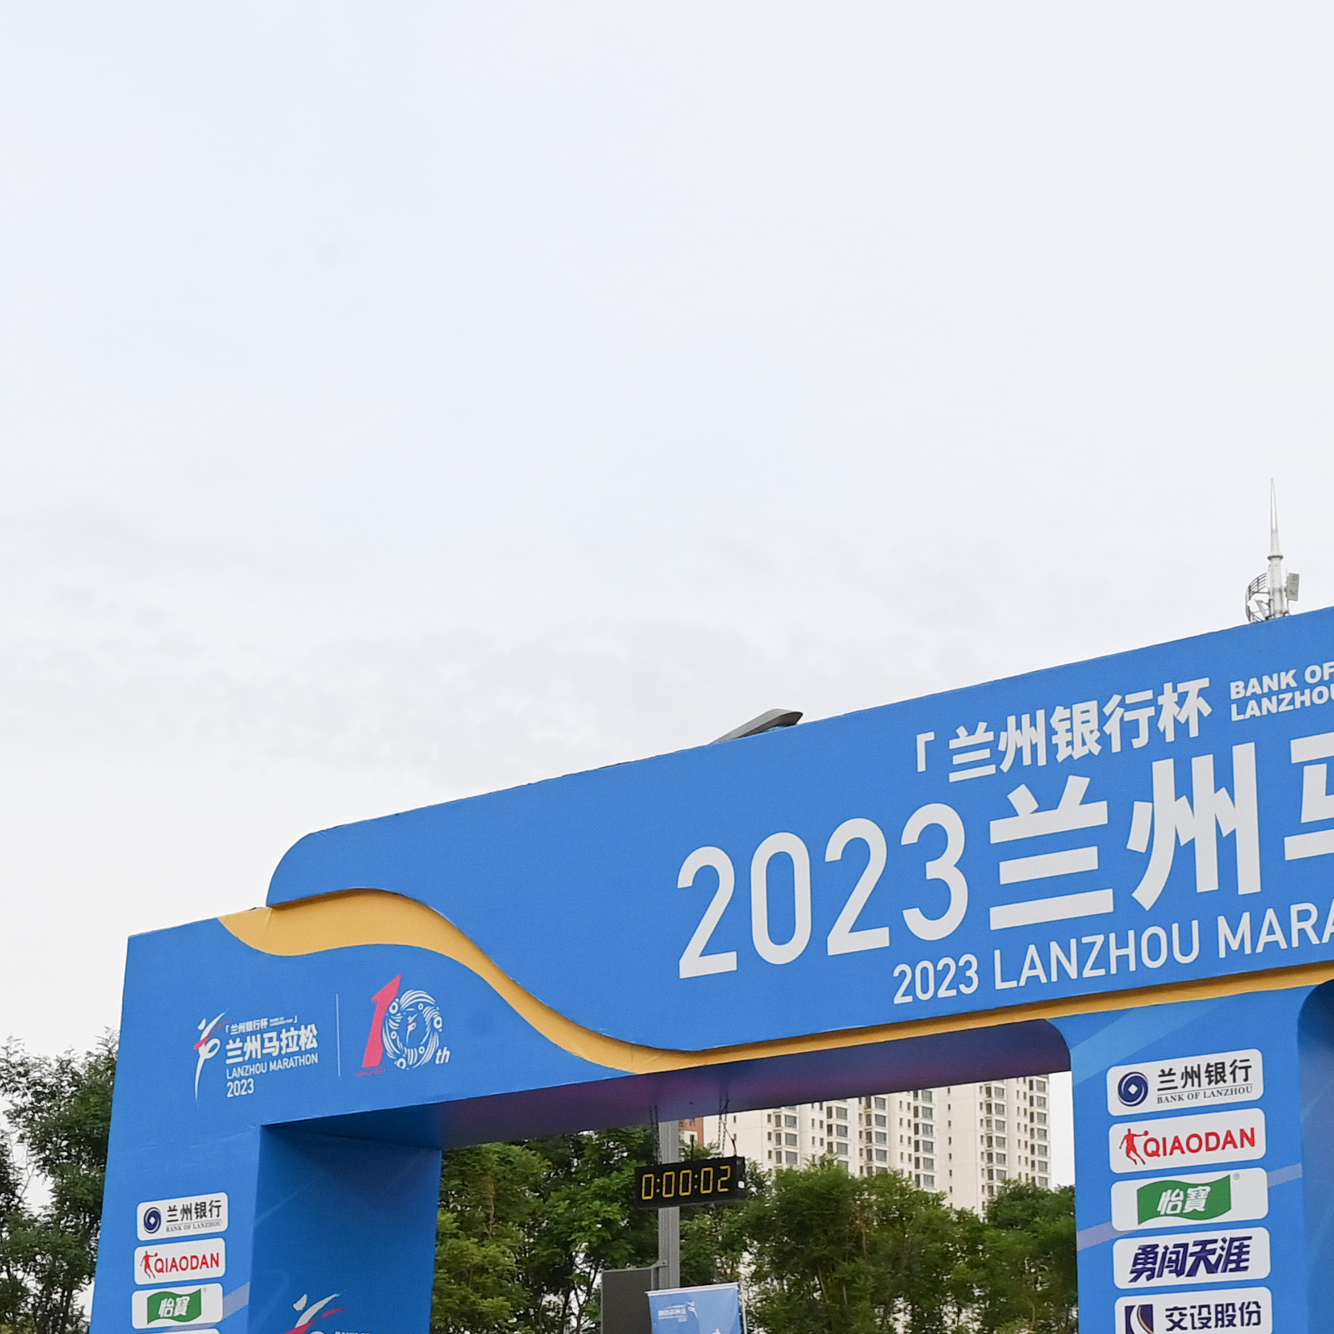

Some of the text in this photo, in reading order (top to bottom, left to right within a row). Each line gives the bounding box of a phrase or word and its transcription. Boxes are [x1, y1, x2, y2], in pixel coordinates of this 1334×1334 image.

[1229, 669, 1298, 700] BANK
[892, 952, 979, 1005] 2023
[993, 920, 1200, 990] LANZHOU
[225, 1023, 318, 1065] 兰州马拉松
[226, 1052, 319, 1080] LANZHOU MARATHON
[1156, 1058, 1253, 1093] 兰州银行
[226, 1077, 255, 1098] 2023
[1156, 1084, 1253, 1105] BANK OF LANZHOU
[1143, 1127, 1255, 1159] QIAODAN
[641, 1164, 732, 1200] 0:00:02
[166, 1199, 222, 1223] 兰州银行
[154, 1251, 220, 1275] QIAODAN
[1128, 1235, 1253, 1284] 勇闯天涯
[1165, 1301, 1261, 1333] 交设股份
